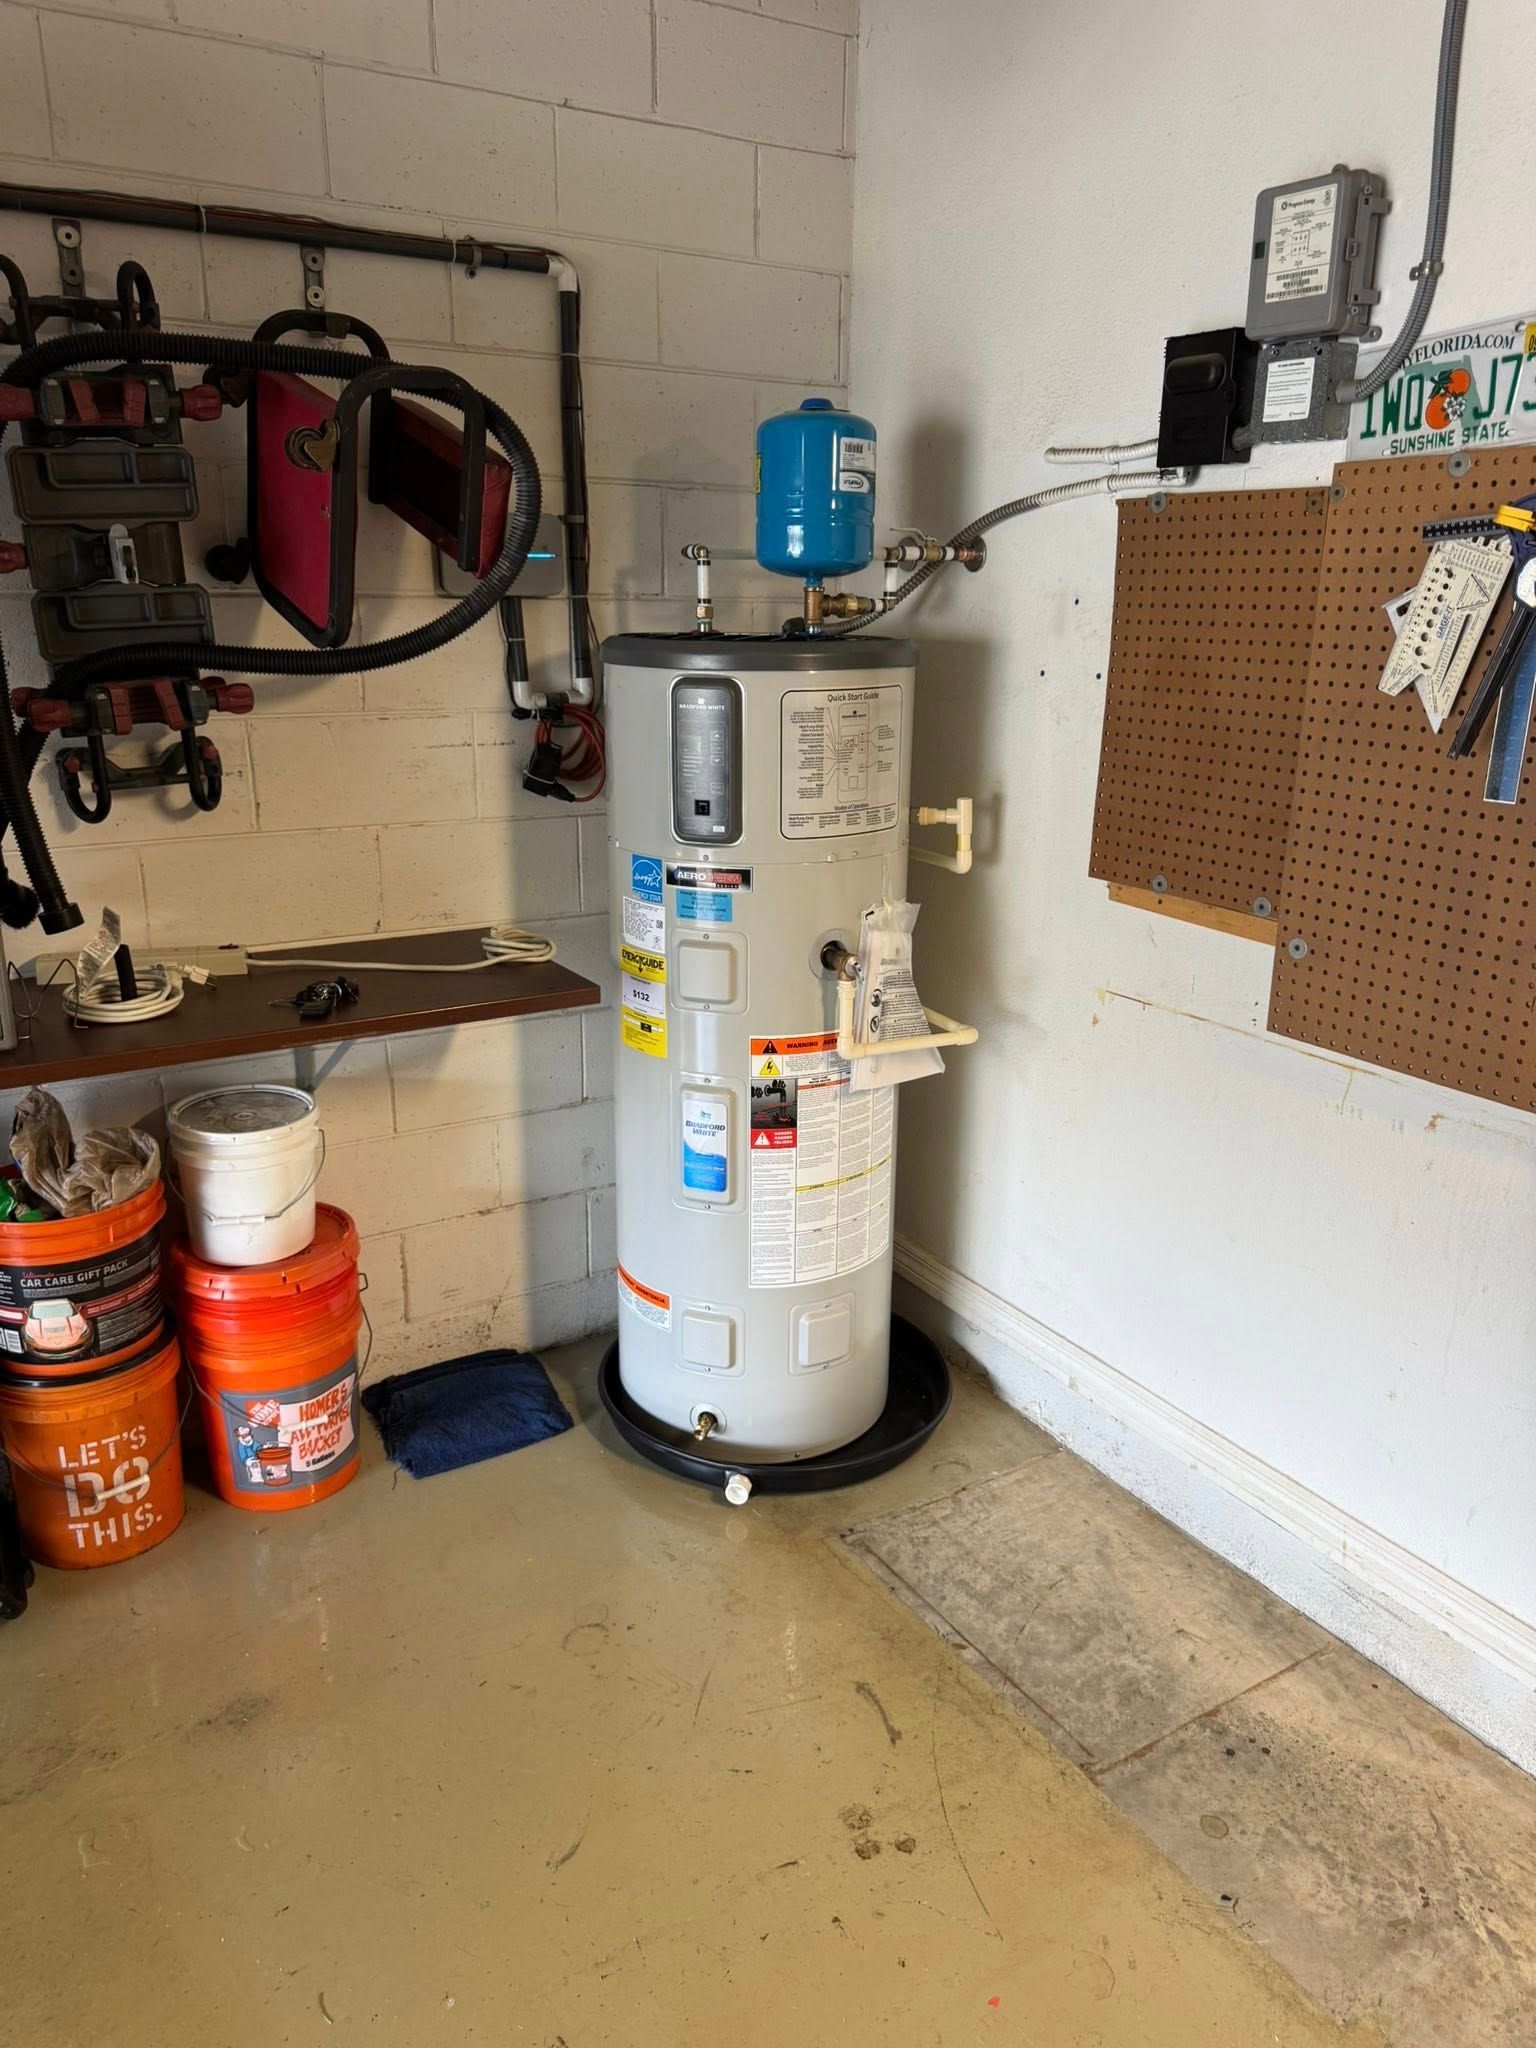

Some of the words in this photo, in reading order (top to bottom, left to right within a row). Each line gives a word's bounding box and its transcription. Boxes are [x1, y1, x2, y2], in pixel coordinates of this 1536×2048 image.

[1390, 429, 1456, 455] SUNSHINE
[1462, 421, 1507, 445] STATE
[827, 693, 847, 703] Quick
[847, 693, 863, 701] Start
[863, 690, 879, 700] Guide
[632, 989, 650, 1002] $132
[786, 1041, 819, 1049] WARNING
[685, 1120, 726, 1131] BRADFORD
[692, 1128, 717, 1137] WHITE
[20, 1278, 42, 1288] CAR
[45, 1274, 75, 1287] CARE
[77, 1268, 101, 1282] GIFT
[103, 1258, 129, 1275] PACK
[248, 1399, 280, 1427] HOME
[58, 1425, 147, 1469] LET'S
[299, 1425, 344, 1460] BUCKET
[306, 1460, 311, 1468] 5
[311, 1451, 336, 1465] Gallons
[64, 1456, 151, 1518] DO
[68, 1503, 162, 1549] THIS.
